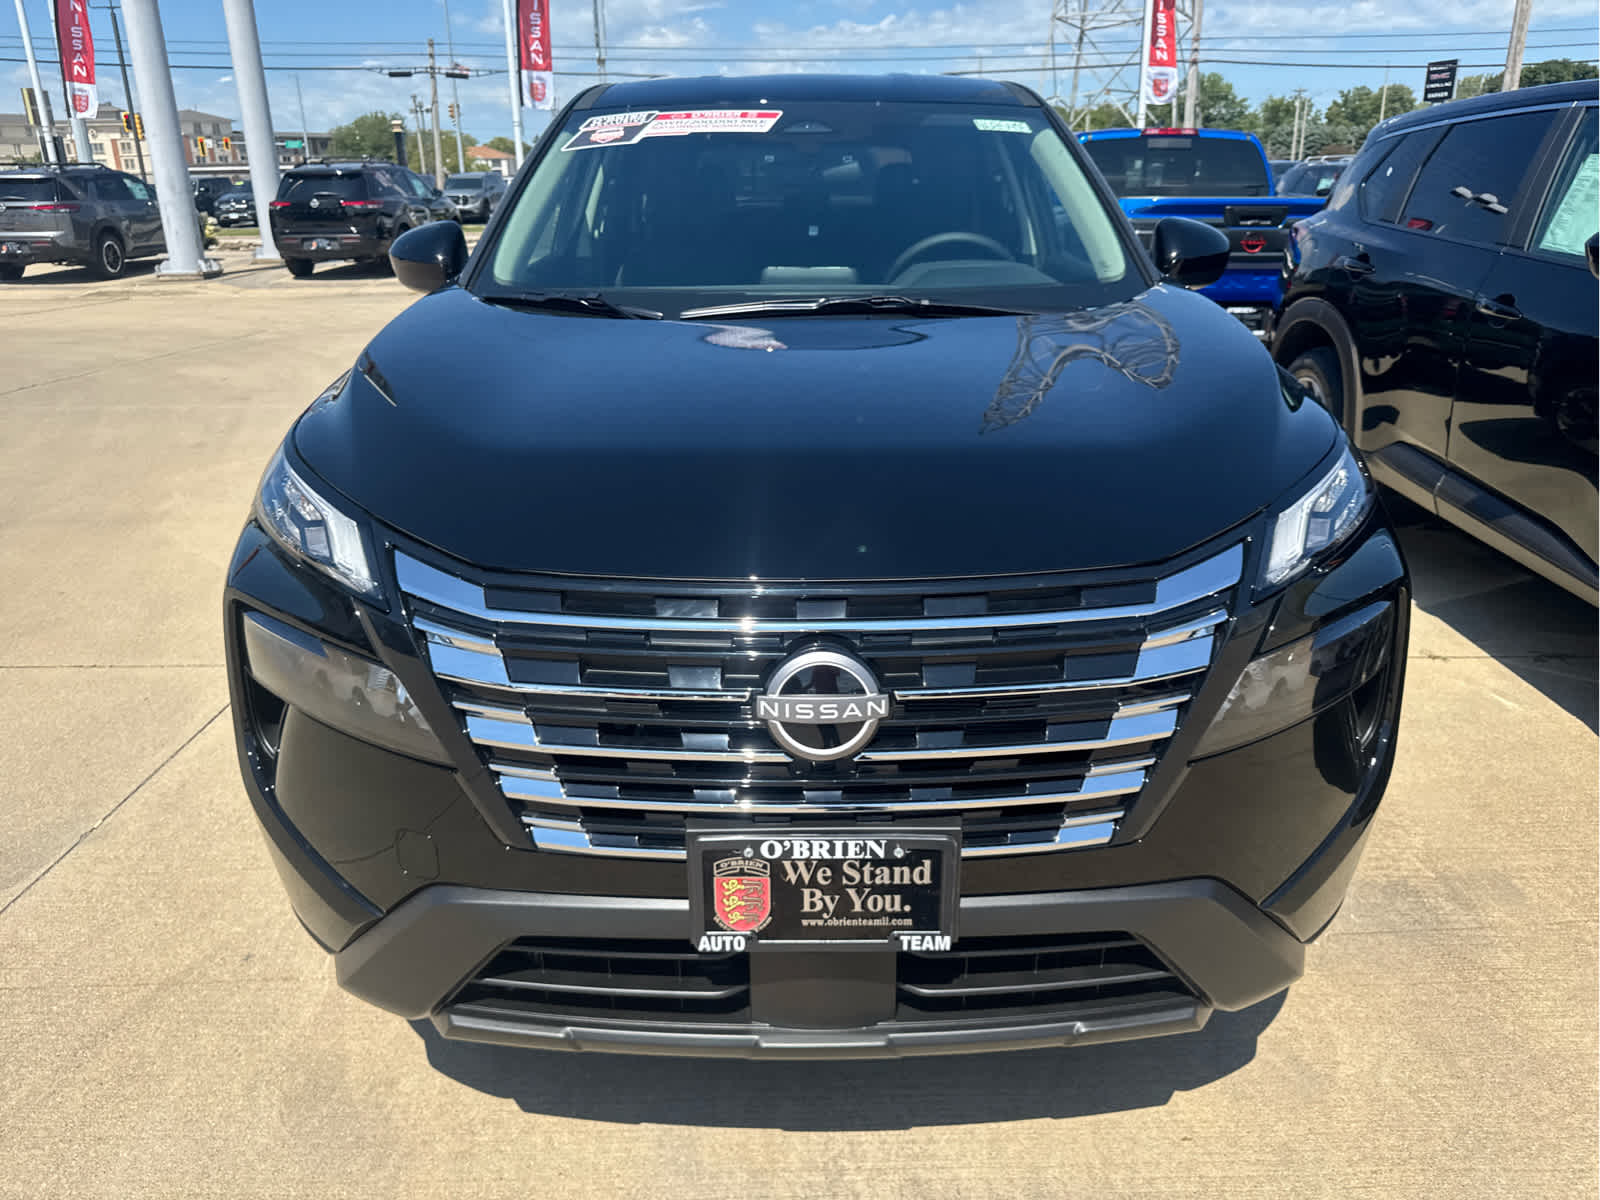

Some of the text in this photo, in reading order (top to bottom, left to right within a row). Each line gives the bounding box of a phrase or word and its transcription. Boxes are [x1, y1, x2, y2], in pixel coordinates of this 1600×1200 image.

[759, 699, 886, 720] NISSAN
[760, 840, 886, 859] O'BRIEN
[782, 859, 932, 885] We Stand
[800, 888, 912, 918] By You.
[698, 936, 951, 951] AUTO TEAM
